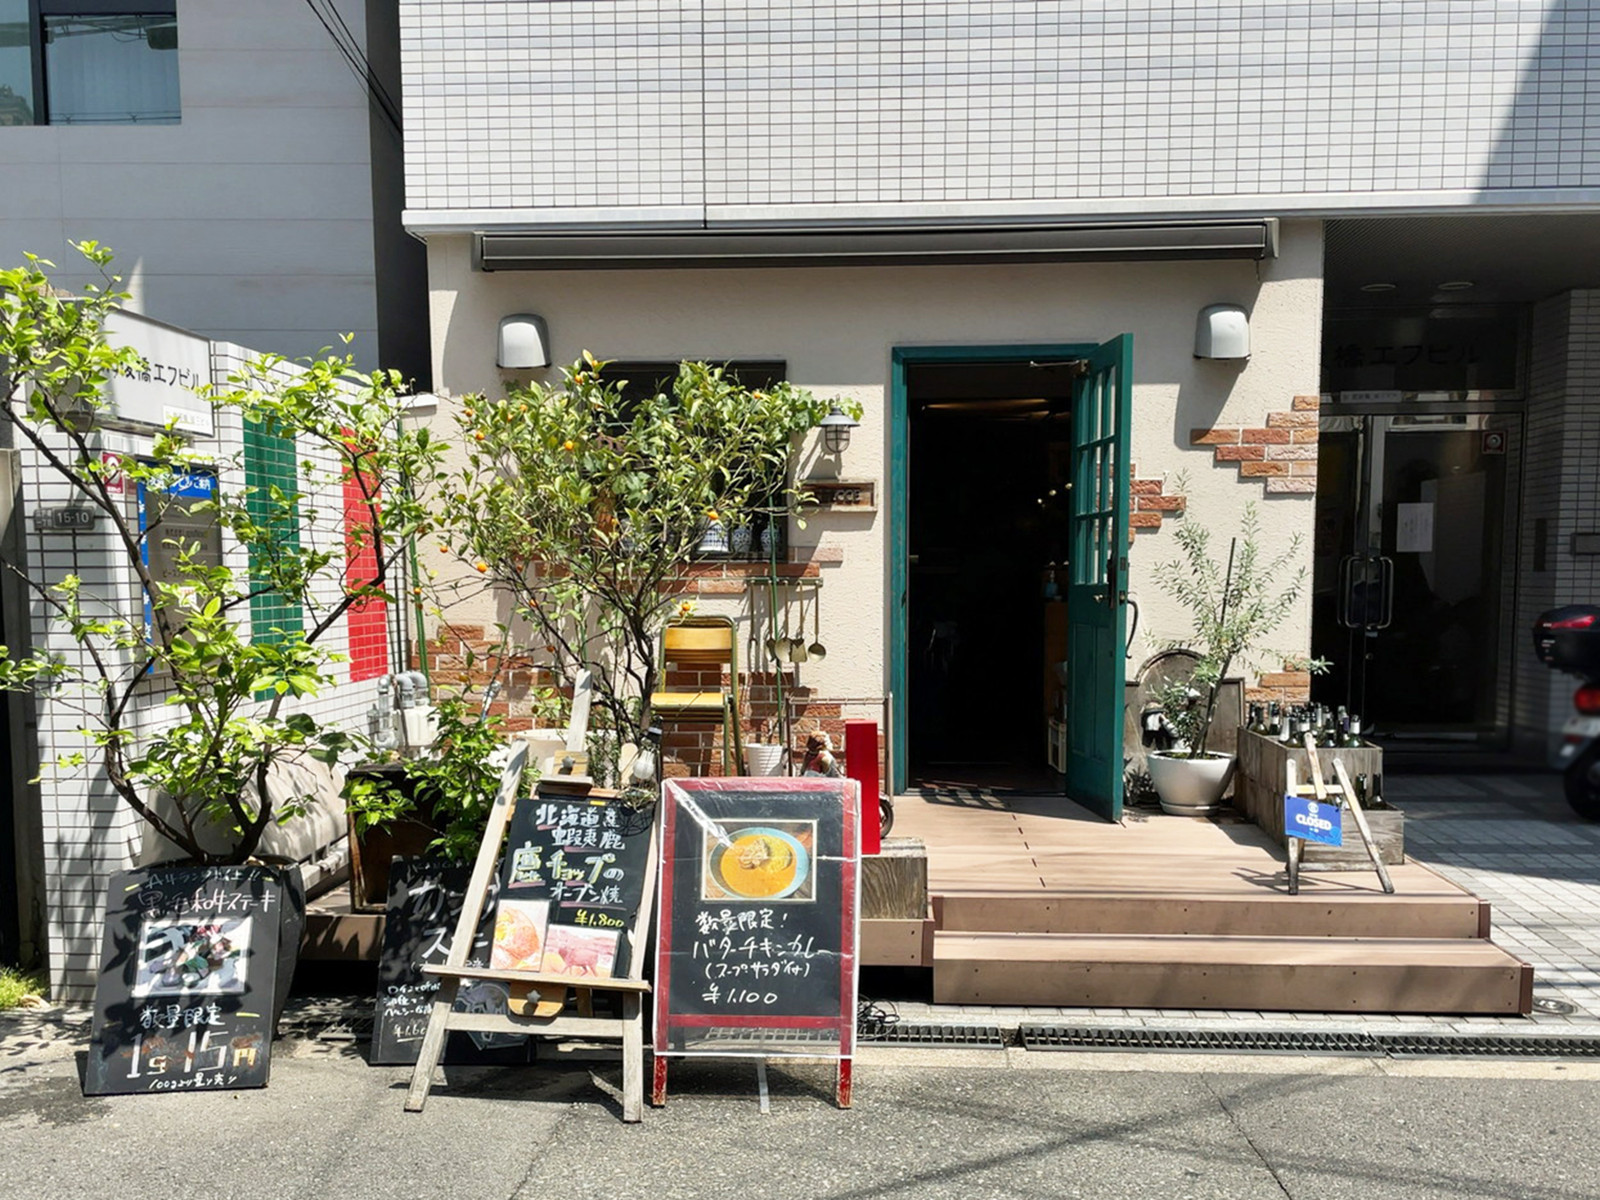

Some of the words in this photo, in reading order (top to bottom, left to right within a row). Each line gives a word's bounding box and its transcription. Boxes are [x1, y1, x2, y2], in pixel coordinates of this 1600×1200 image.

[1295, 813, 1332, 831] CLOSED
[140, 1002, 226, 1029] 数量限定
